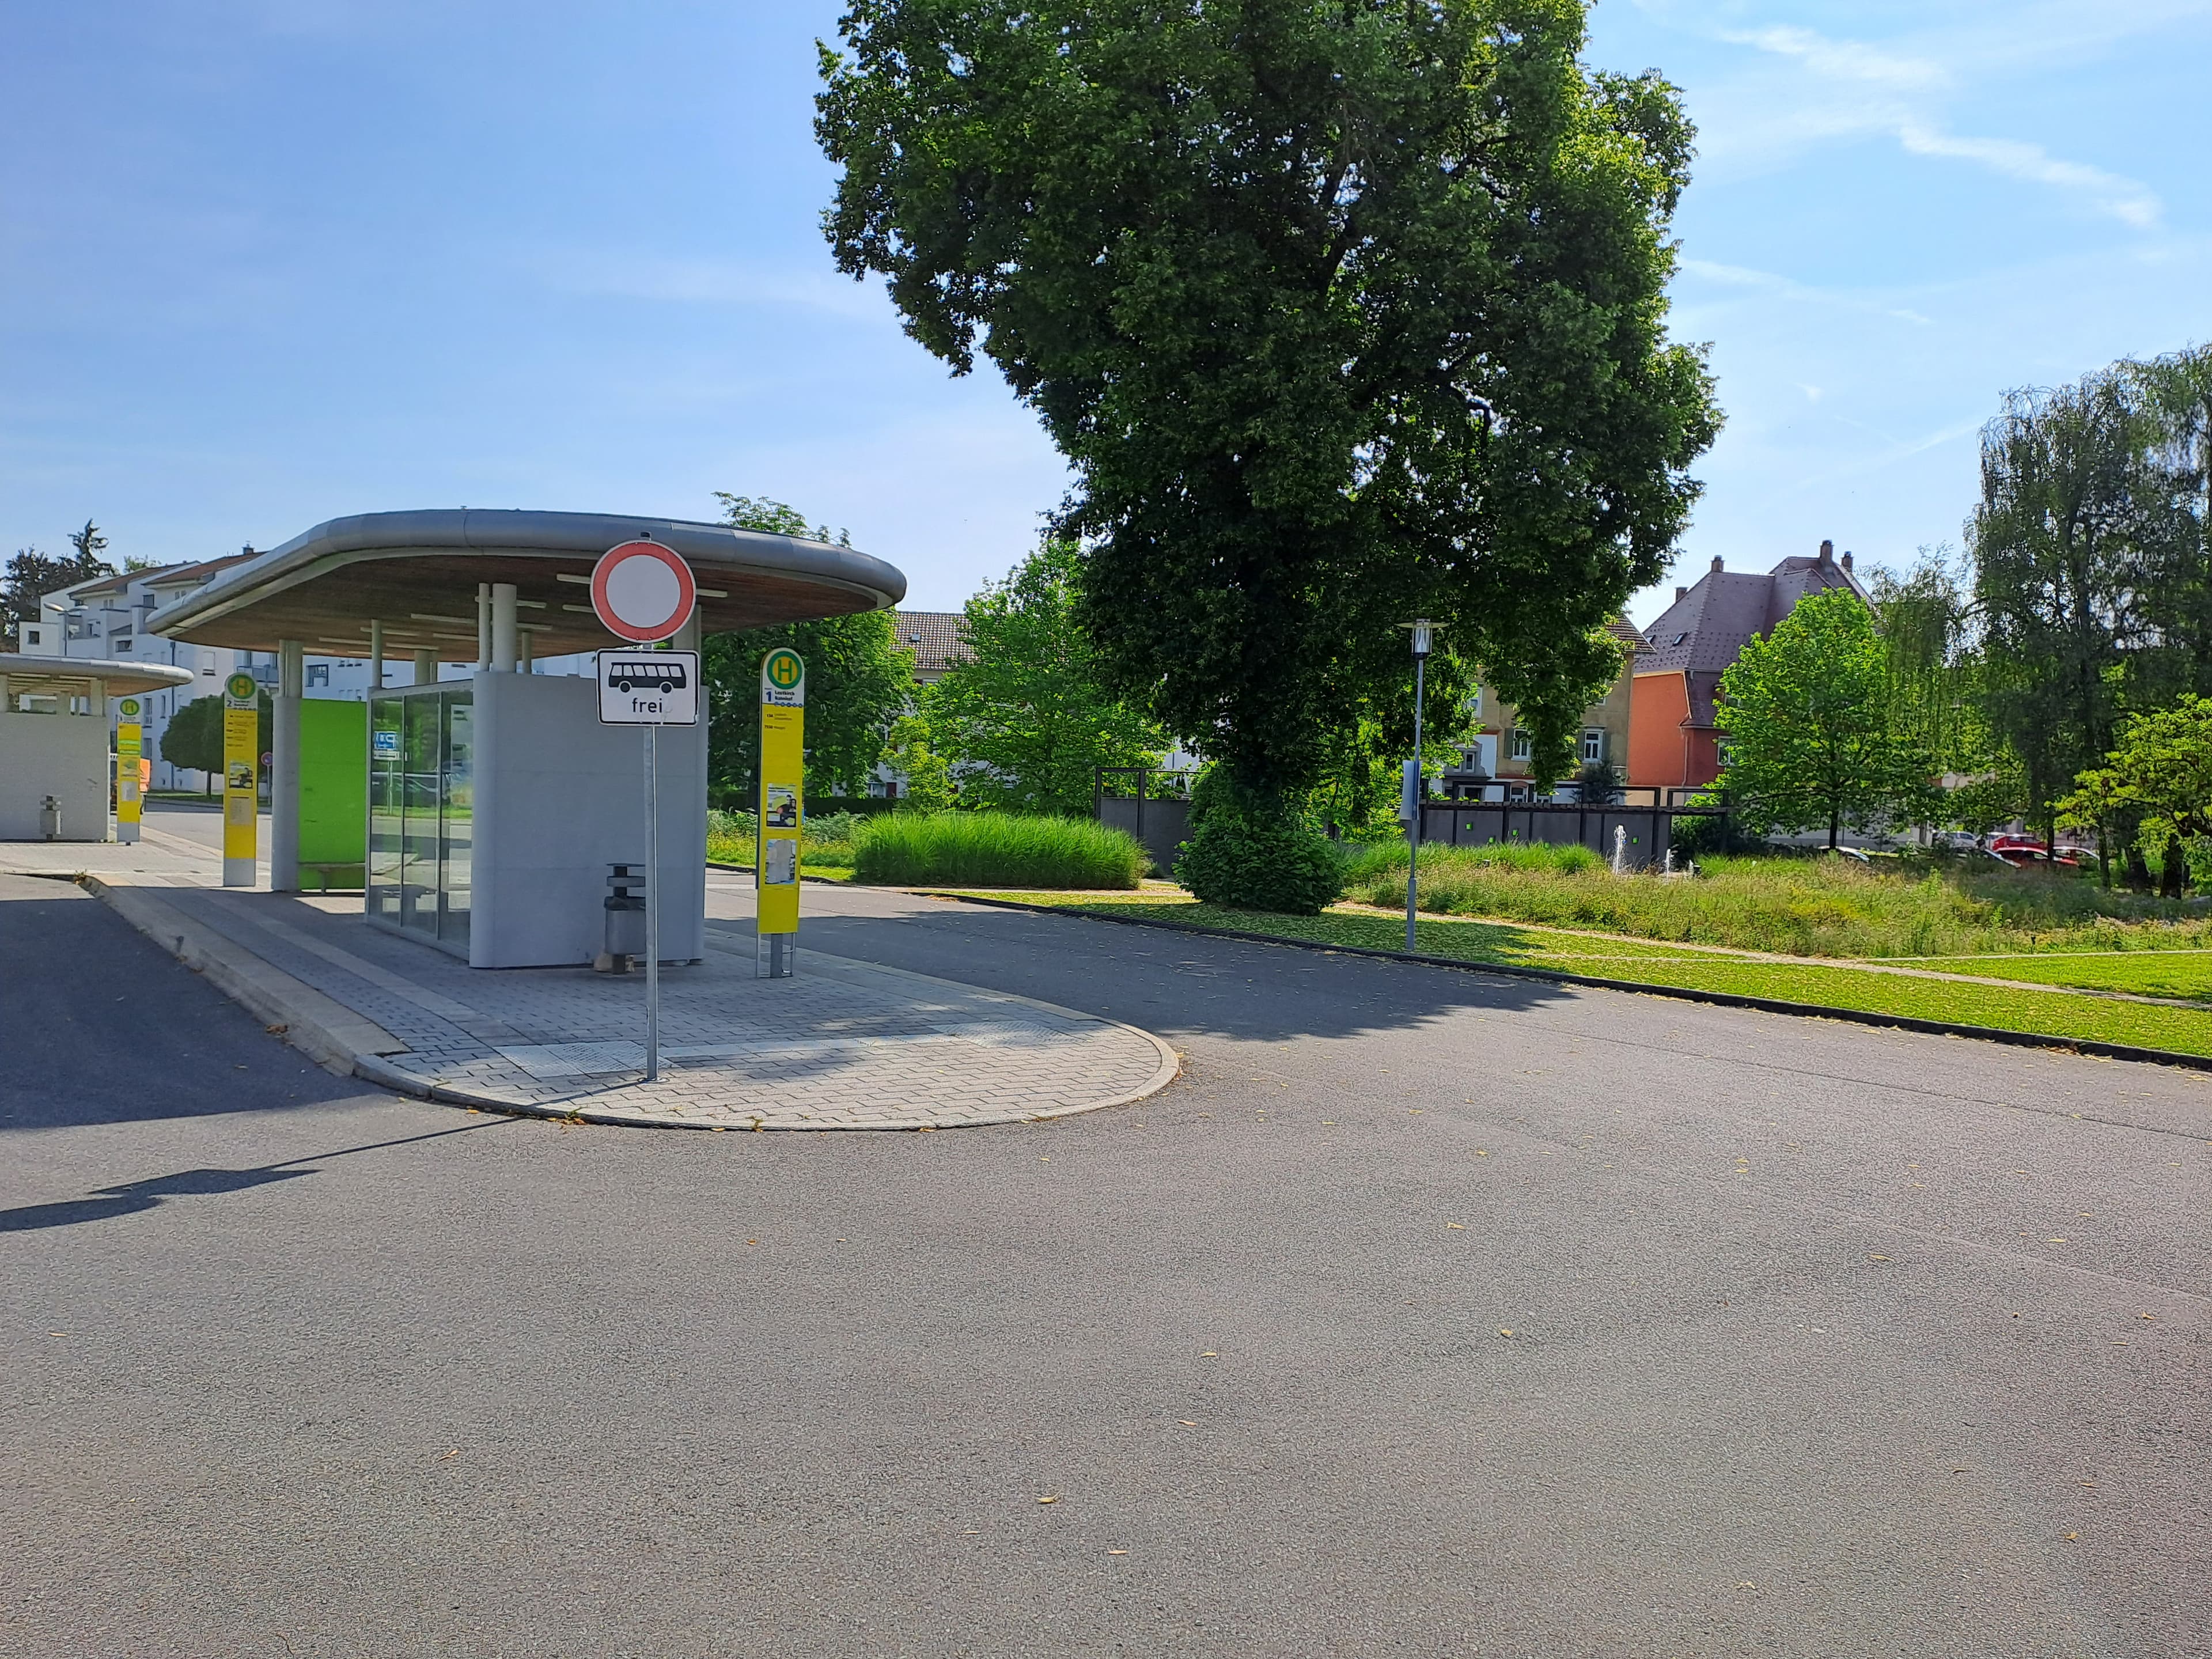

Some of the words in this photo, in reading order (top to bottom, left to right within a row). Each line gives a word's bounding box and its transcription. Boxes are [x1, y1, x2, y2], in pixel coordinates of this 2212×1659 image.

[778, 660, 792, 681] H
[236, 679, 248, 695] H
[766, 691, 771, 702] 1
[126, 702, 134, 713] H
[632, 698, 662, 713] frei
